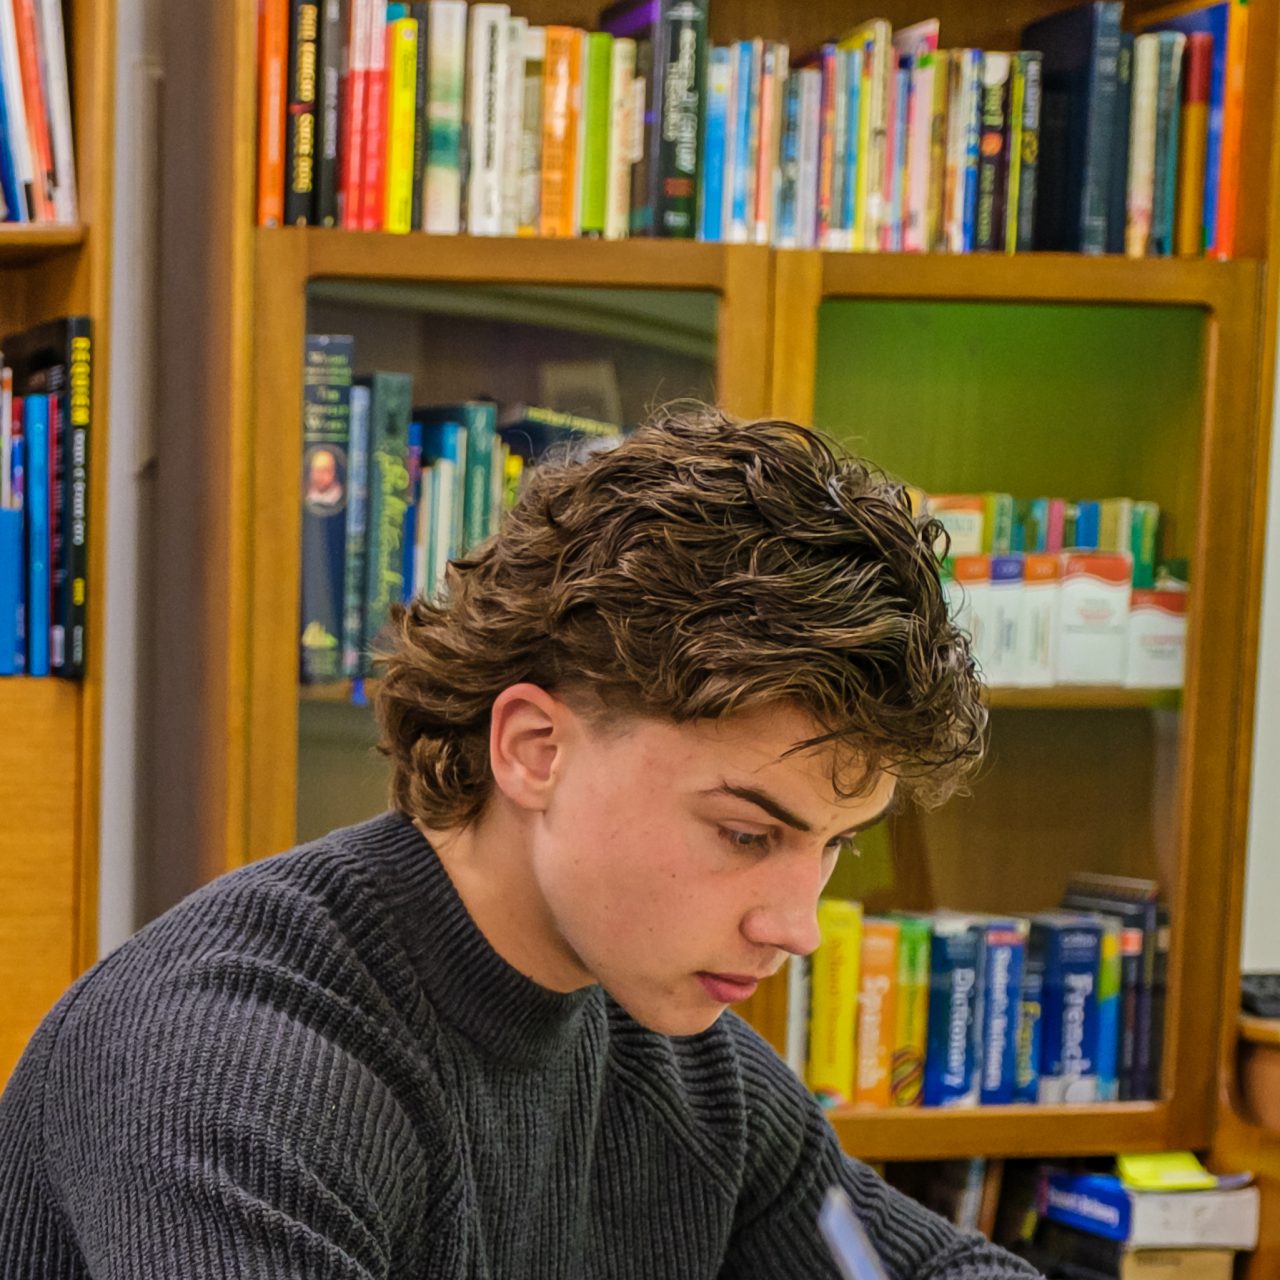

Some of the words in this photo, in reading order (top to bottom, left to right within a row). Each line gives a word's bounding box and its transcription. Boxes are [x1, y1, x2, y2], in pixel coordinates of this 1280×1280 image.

[71, 337, 91, 425] REQUIEM
[857, 974, 891, 1088] Spanish
[945, 968, 976, 1089] Dictionary
[1061, 973, 1094, 1075] French
